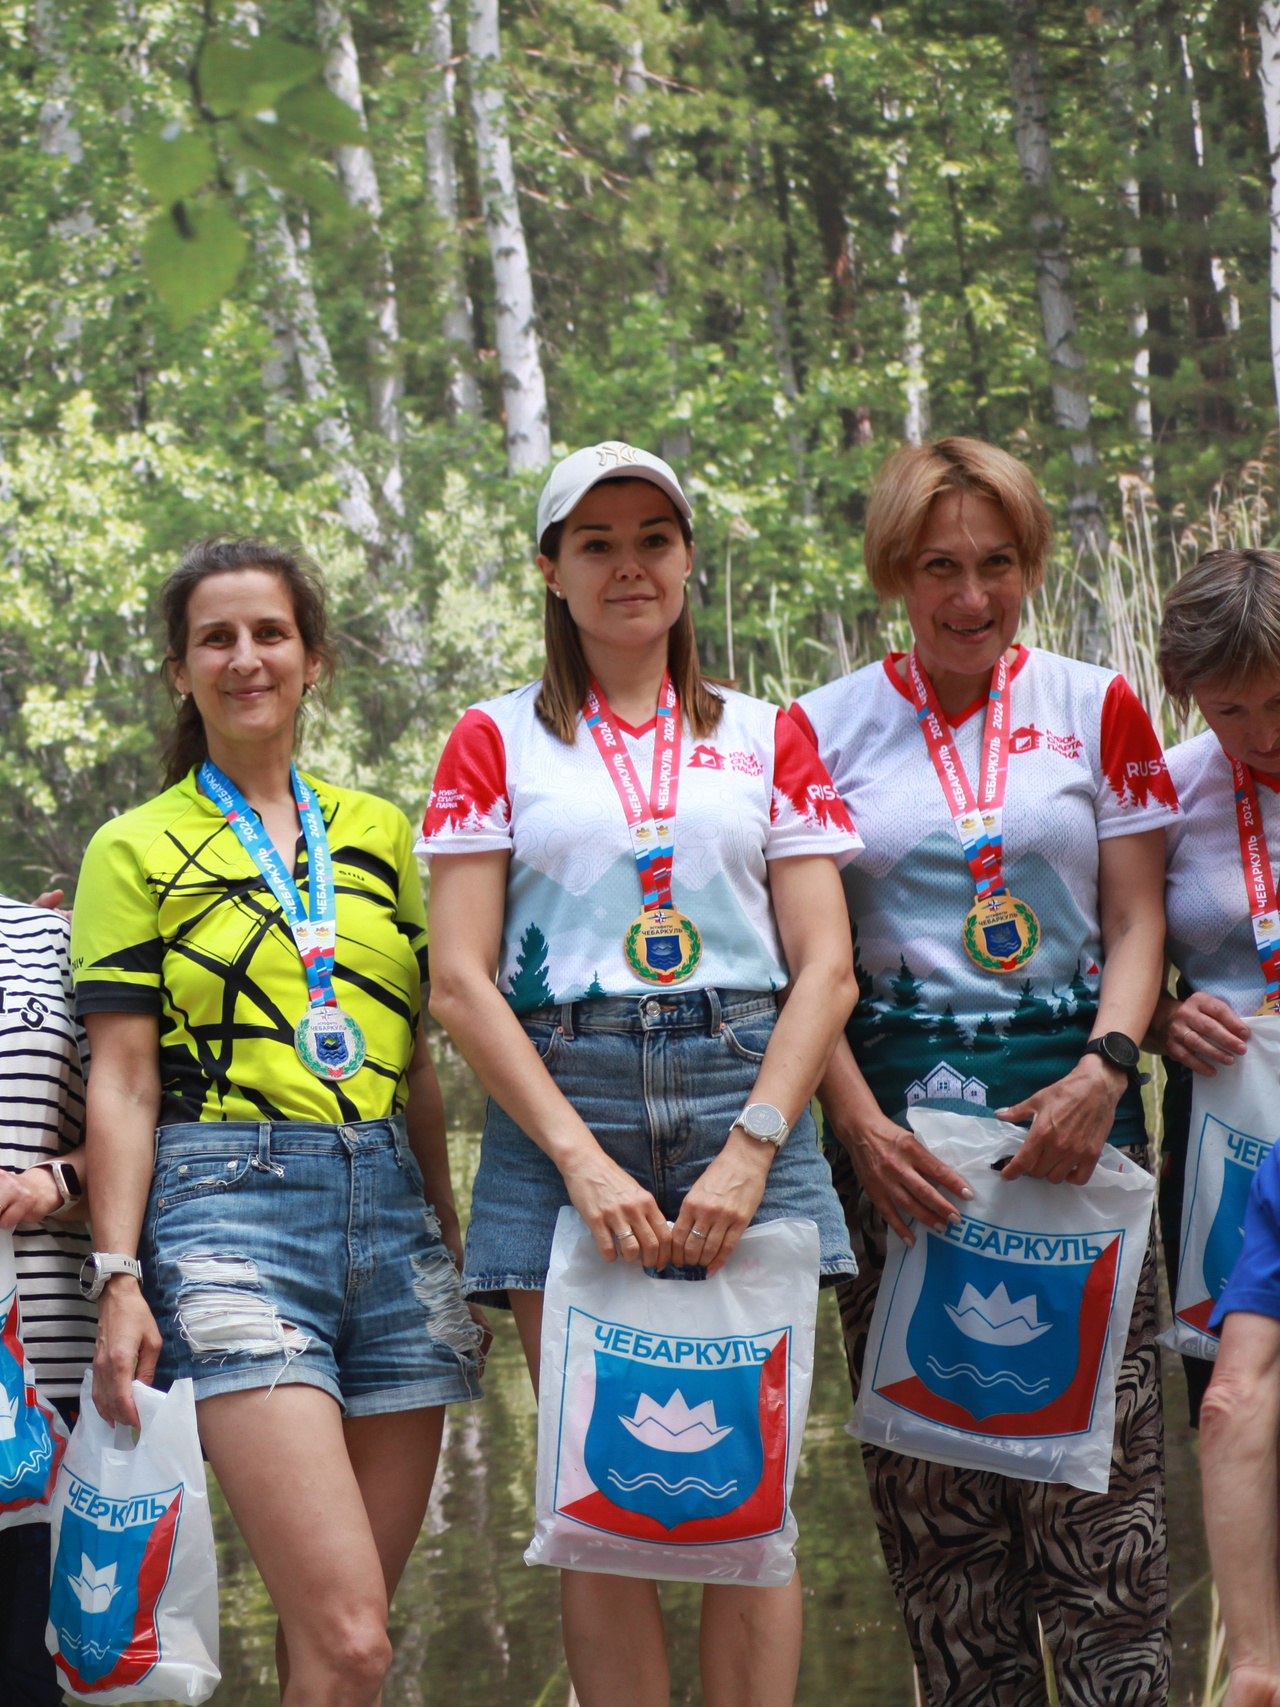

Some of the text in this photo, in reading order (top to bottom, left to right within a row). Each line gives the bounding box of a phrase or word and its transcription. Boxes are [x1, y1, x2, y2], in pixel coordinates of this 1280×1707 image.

[598, 721, 643, 818] ЧЕБАРКУЛЬ 2024
[658, 717, 675, 811] ЧЕБАРКУЛЬ 2024
[926, 712, 967, 810] ЧЕБАРКУЛЬ 2024
[985, 701, 1004, 803] ЧЕБАРКУЛЬ 2024
[236, 815, 297, 915] ЧЕБАРКУЛЬ 2024
[306, 813, 327, 915] ЧЕБАРКУЛЬ 2024
[1241, 797, 1267, 908] ЧЕБАРКУЛЬ 2024
[642, 928, 683, 936] ЧЕБАРКУЛЬ
[937, 1219, 1104, 1261] ЕБАРКУЛЬ
[594, 1325, 772, 1366] ЧЕБАРКУЛЬ
